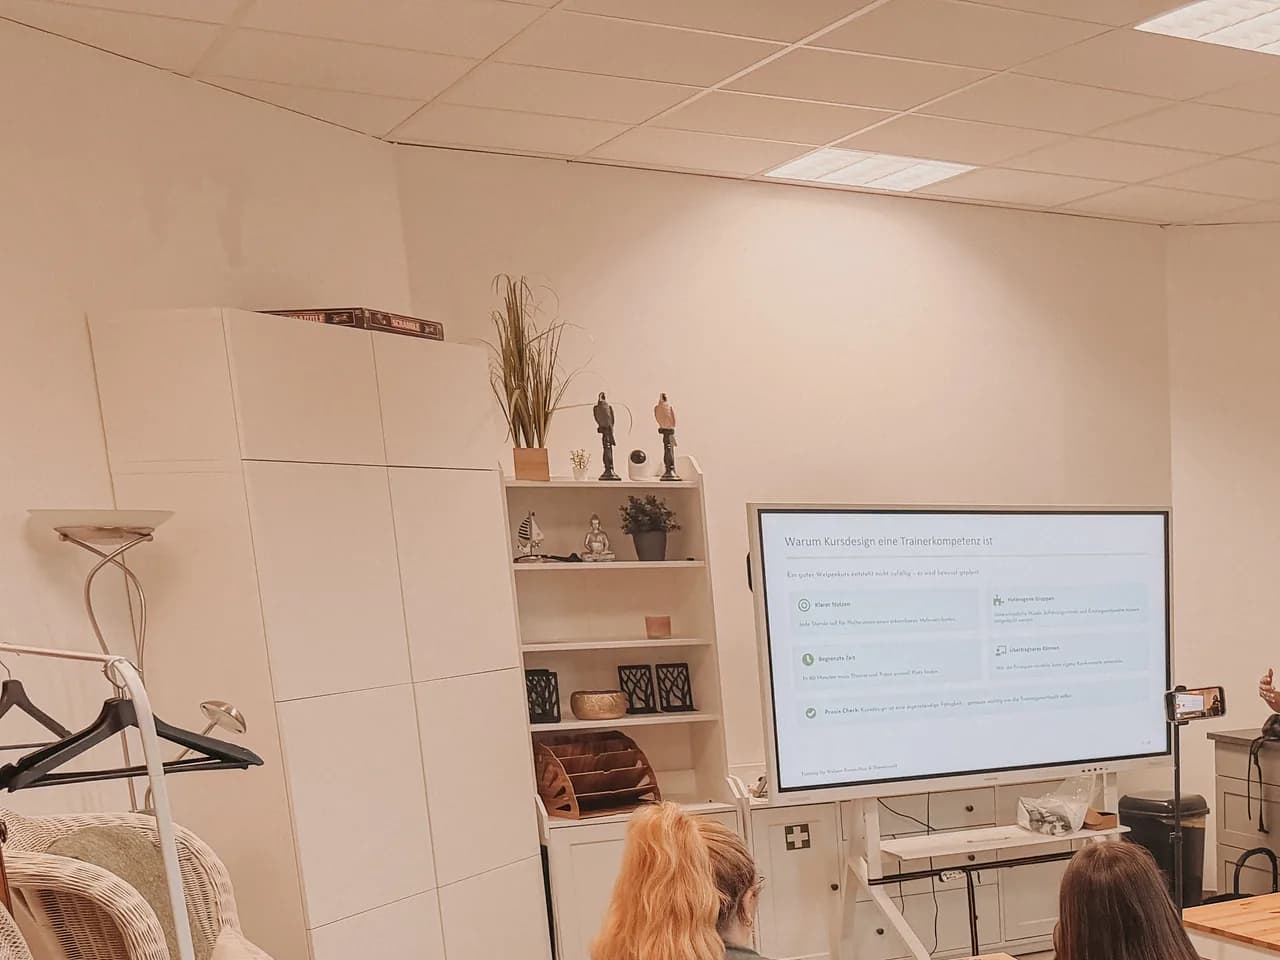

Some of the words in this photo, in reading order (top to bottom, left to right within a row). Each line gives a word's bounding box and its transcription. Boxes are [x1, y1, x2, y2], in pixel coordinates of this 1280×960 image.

[390, 318, 421, 332] SCRABBLE
[784, 537, 822, 547] Warum
[824, 536, 876, 548] Kursdesign
[878, 536, 898, 546] eine
[900, 536, 981, 548] Trainerkompetenz
[983, 535, 993, 546] ist
